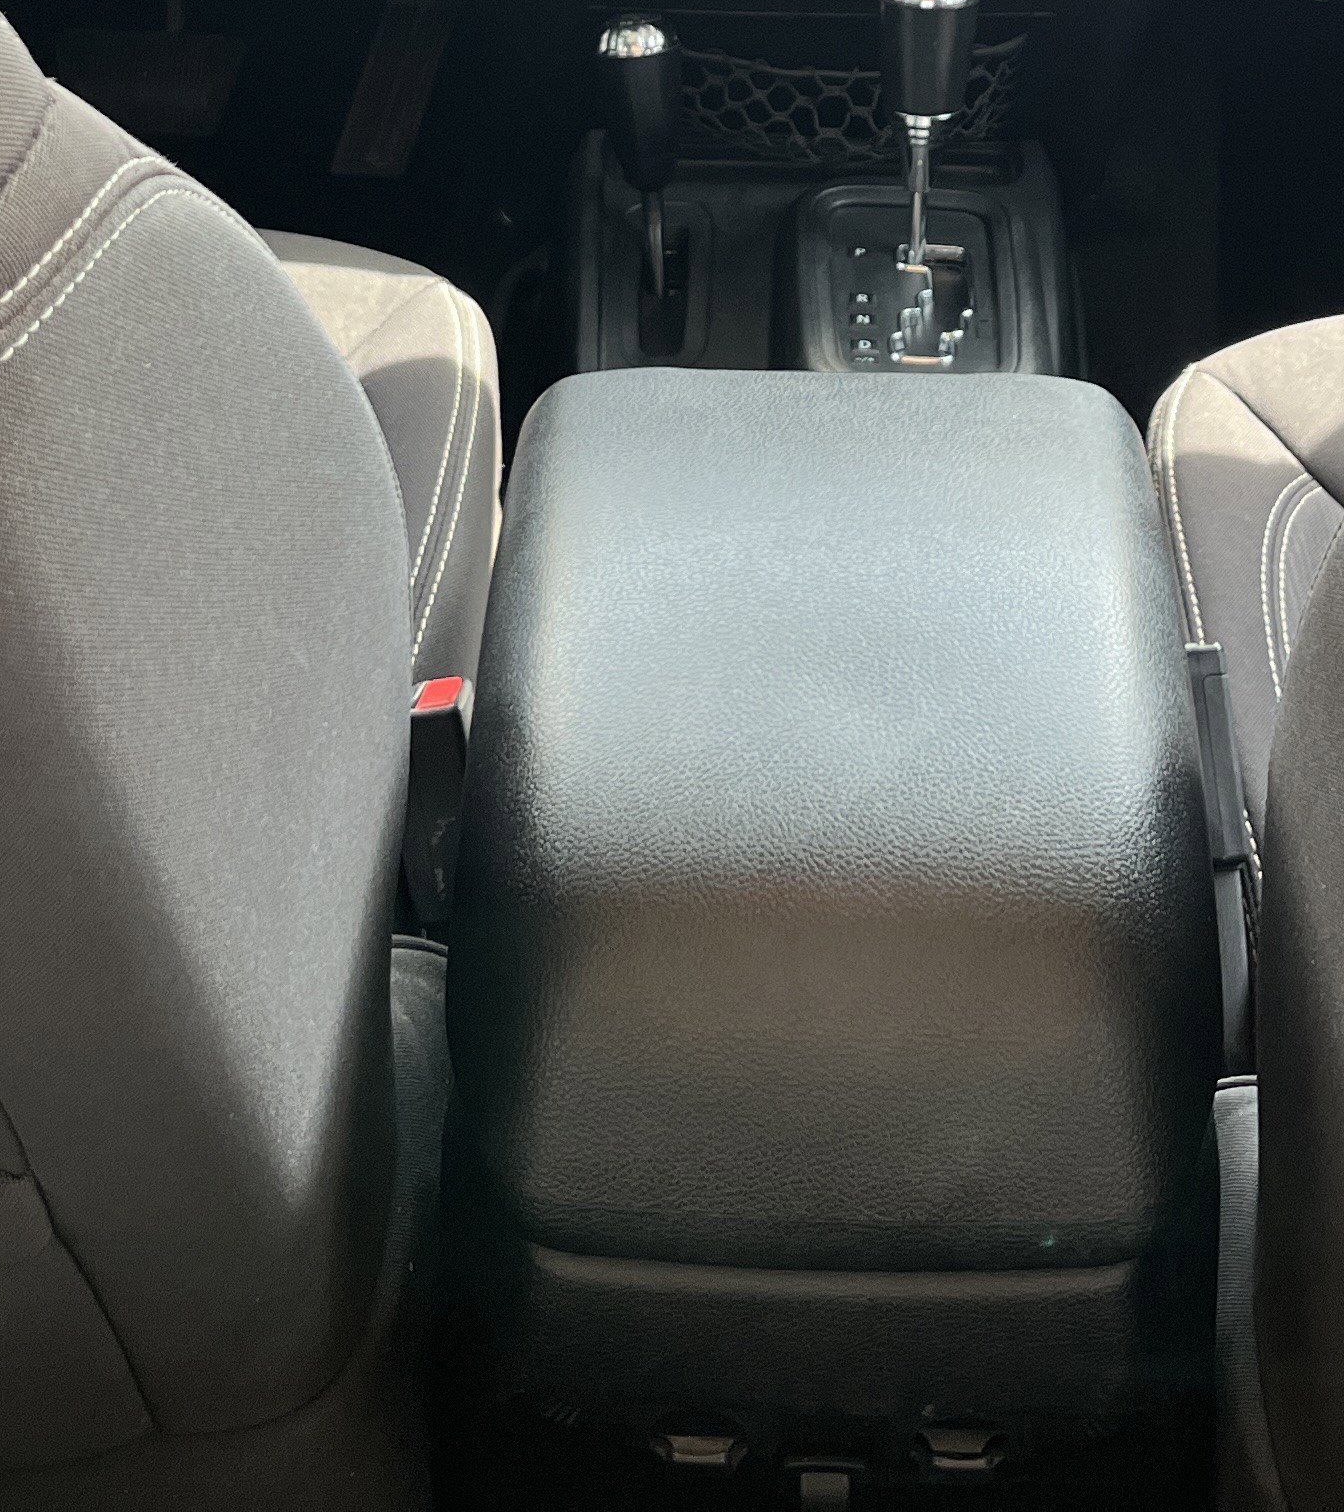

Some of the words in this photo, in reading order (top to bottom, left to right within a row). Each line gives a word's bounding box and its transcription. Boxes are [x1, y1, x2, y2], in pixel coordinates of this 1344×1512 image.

[855, 246, 867, 257] P
[856, 293, 869, 303] R
[856, 314, 870, 324] N
[859, 339, 872, 349] D
